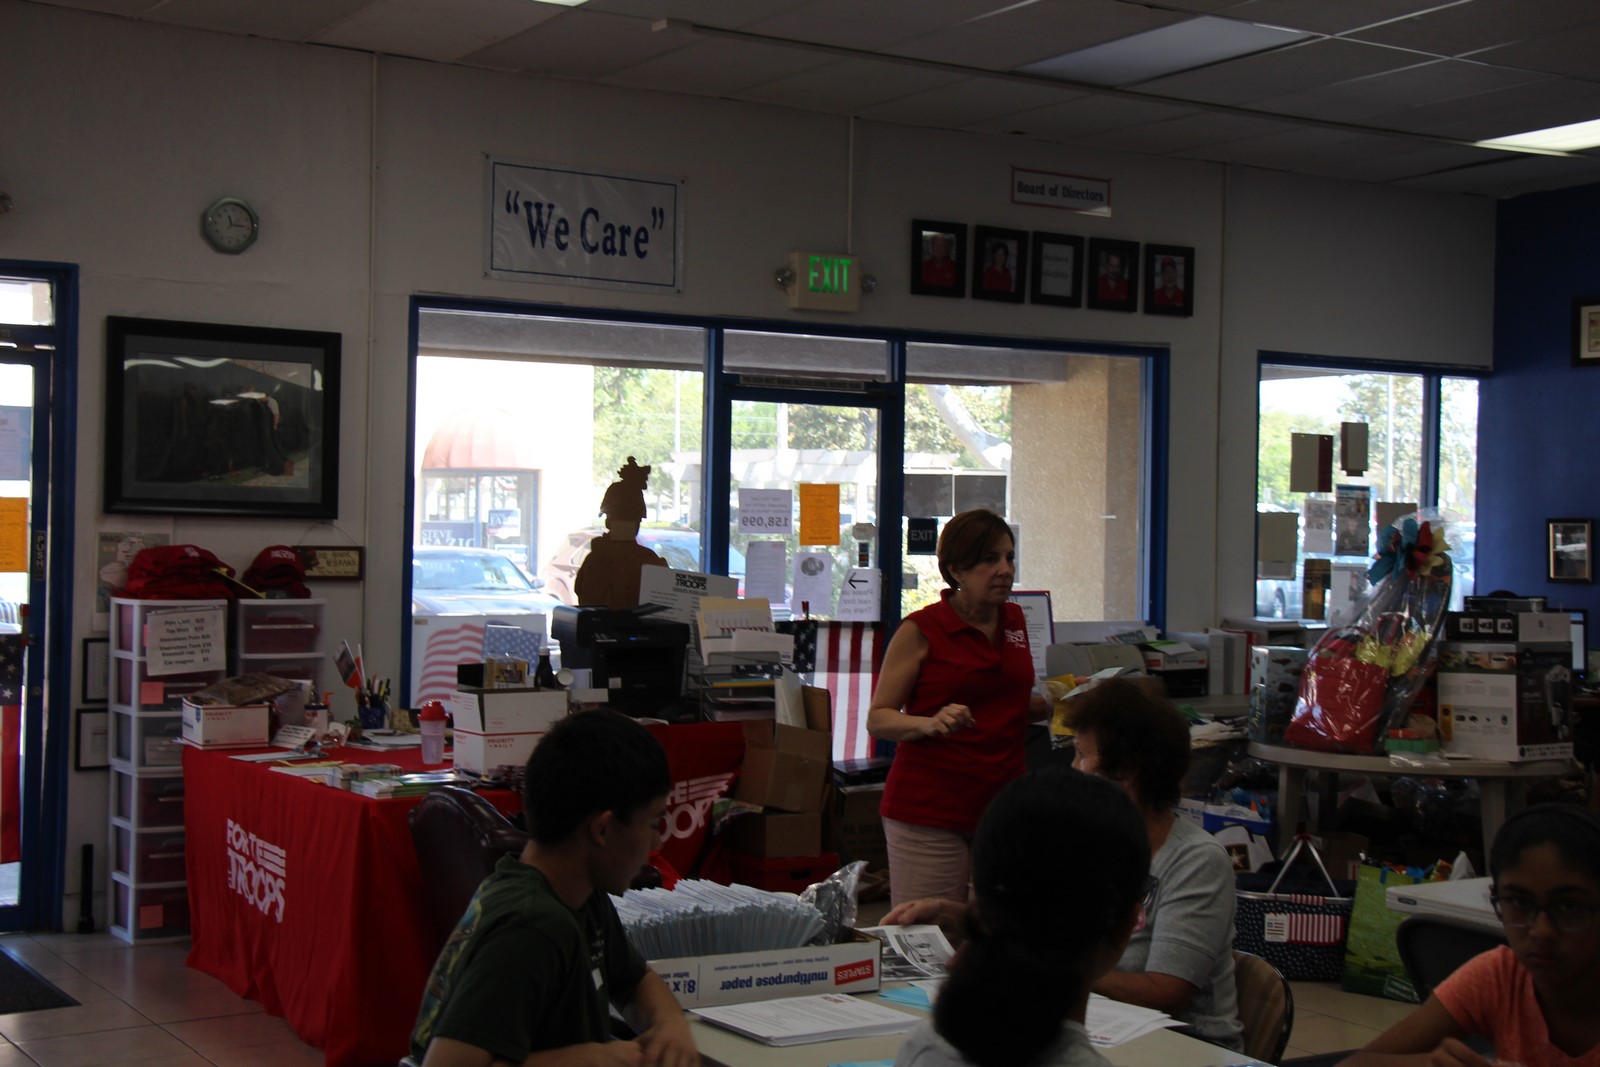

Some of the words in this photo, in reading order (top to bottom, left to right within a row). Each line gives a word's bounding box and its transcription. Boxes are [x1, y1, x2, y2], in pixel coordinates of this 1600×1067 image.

[1017, 181, 1045, 196] Board
[1048, 184, 1059, 198] of
[1062, 186, 1104, 202] Directors
[809, 255, 853, 294] EXIT
[421, 529, 454, 539] STEVE
[910, 529, 936, 542] EXIT
[36, 535, 45, 568] PUSH
[676, 579, 707, 590] TROOPS
[226, 846, 286, 924] TROOPS
[755, 970, 829, 988] multipurpose
[836, 963, 873, 982] STAPLES
[720, 976, 753, 992] paper
